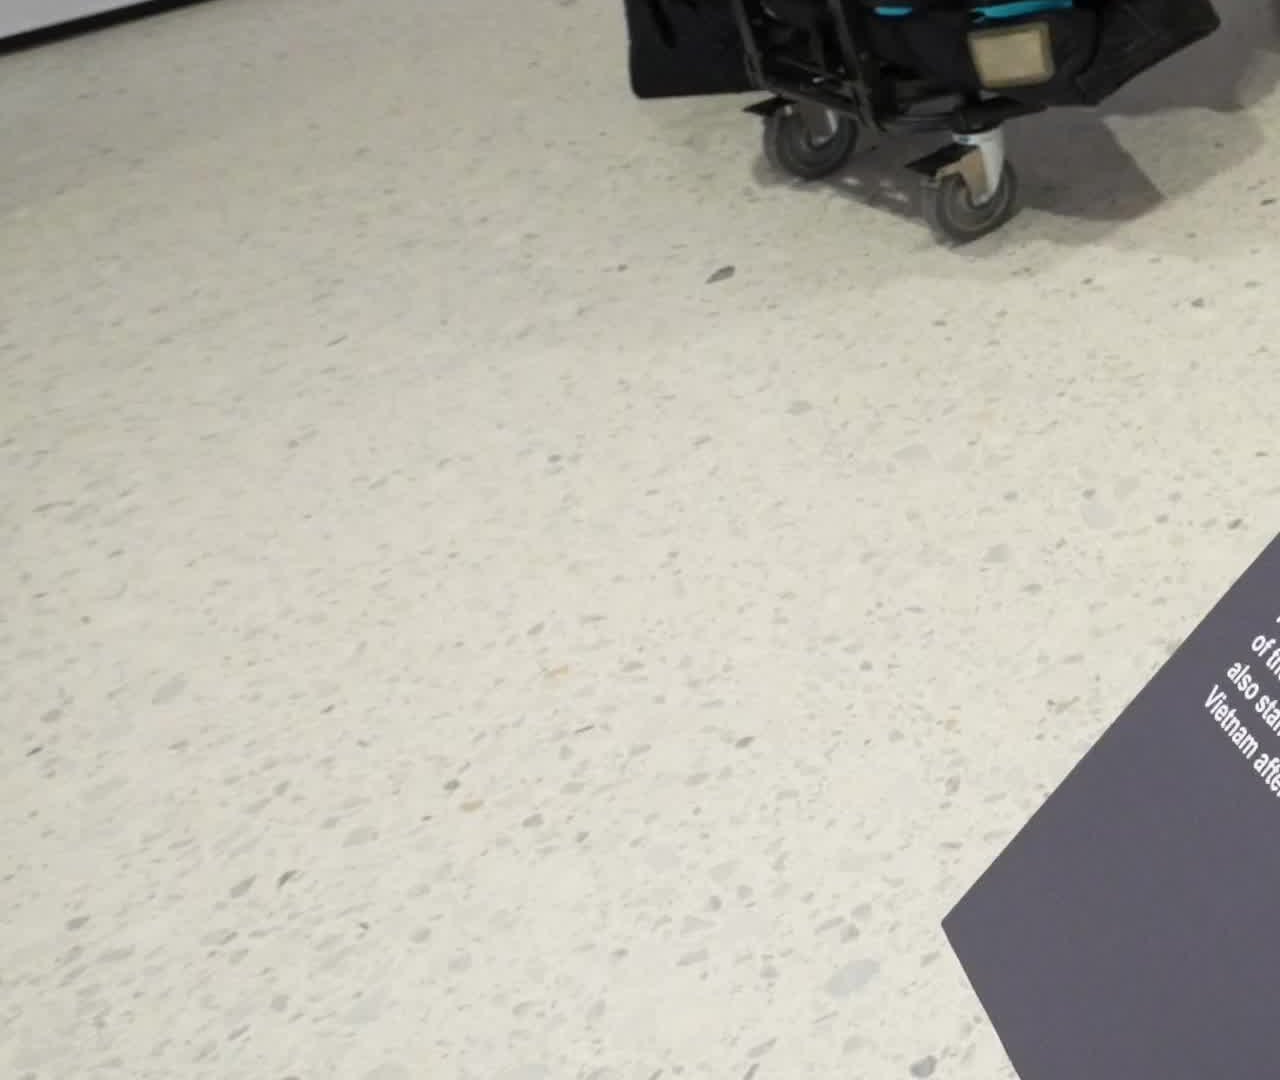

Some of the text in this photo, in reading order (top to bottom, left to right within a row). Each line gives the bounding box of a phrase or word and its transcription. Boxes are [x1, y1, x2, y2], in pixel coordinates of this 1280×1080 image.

[1251, 635, 1276, 656] of
[1227, 663, 1259, 700] also
[1205, 684, 1258, 759] Vietnam
